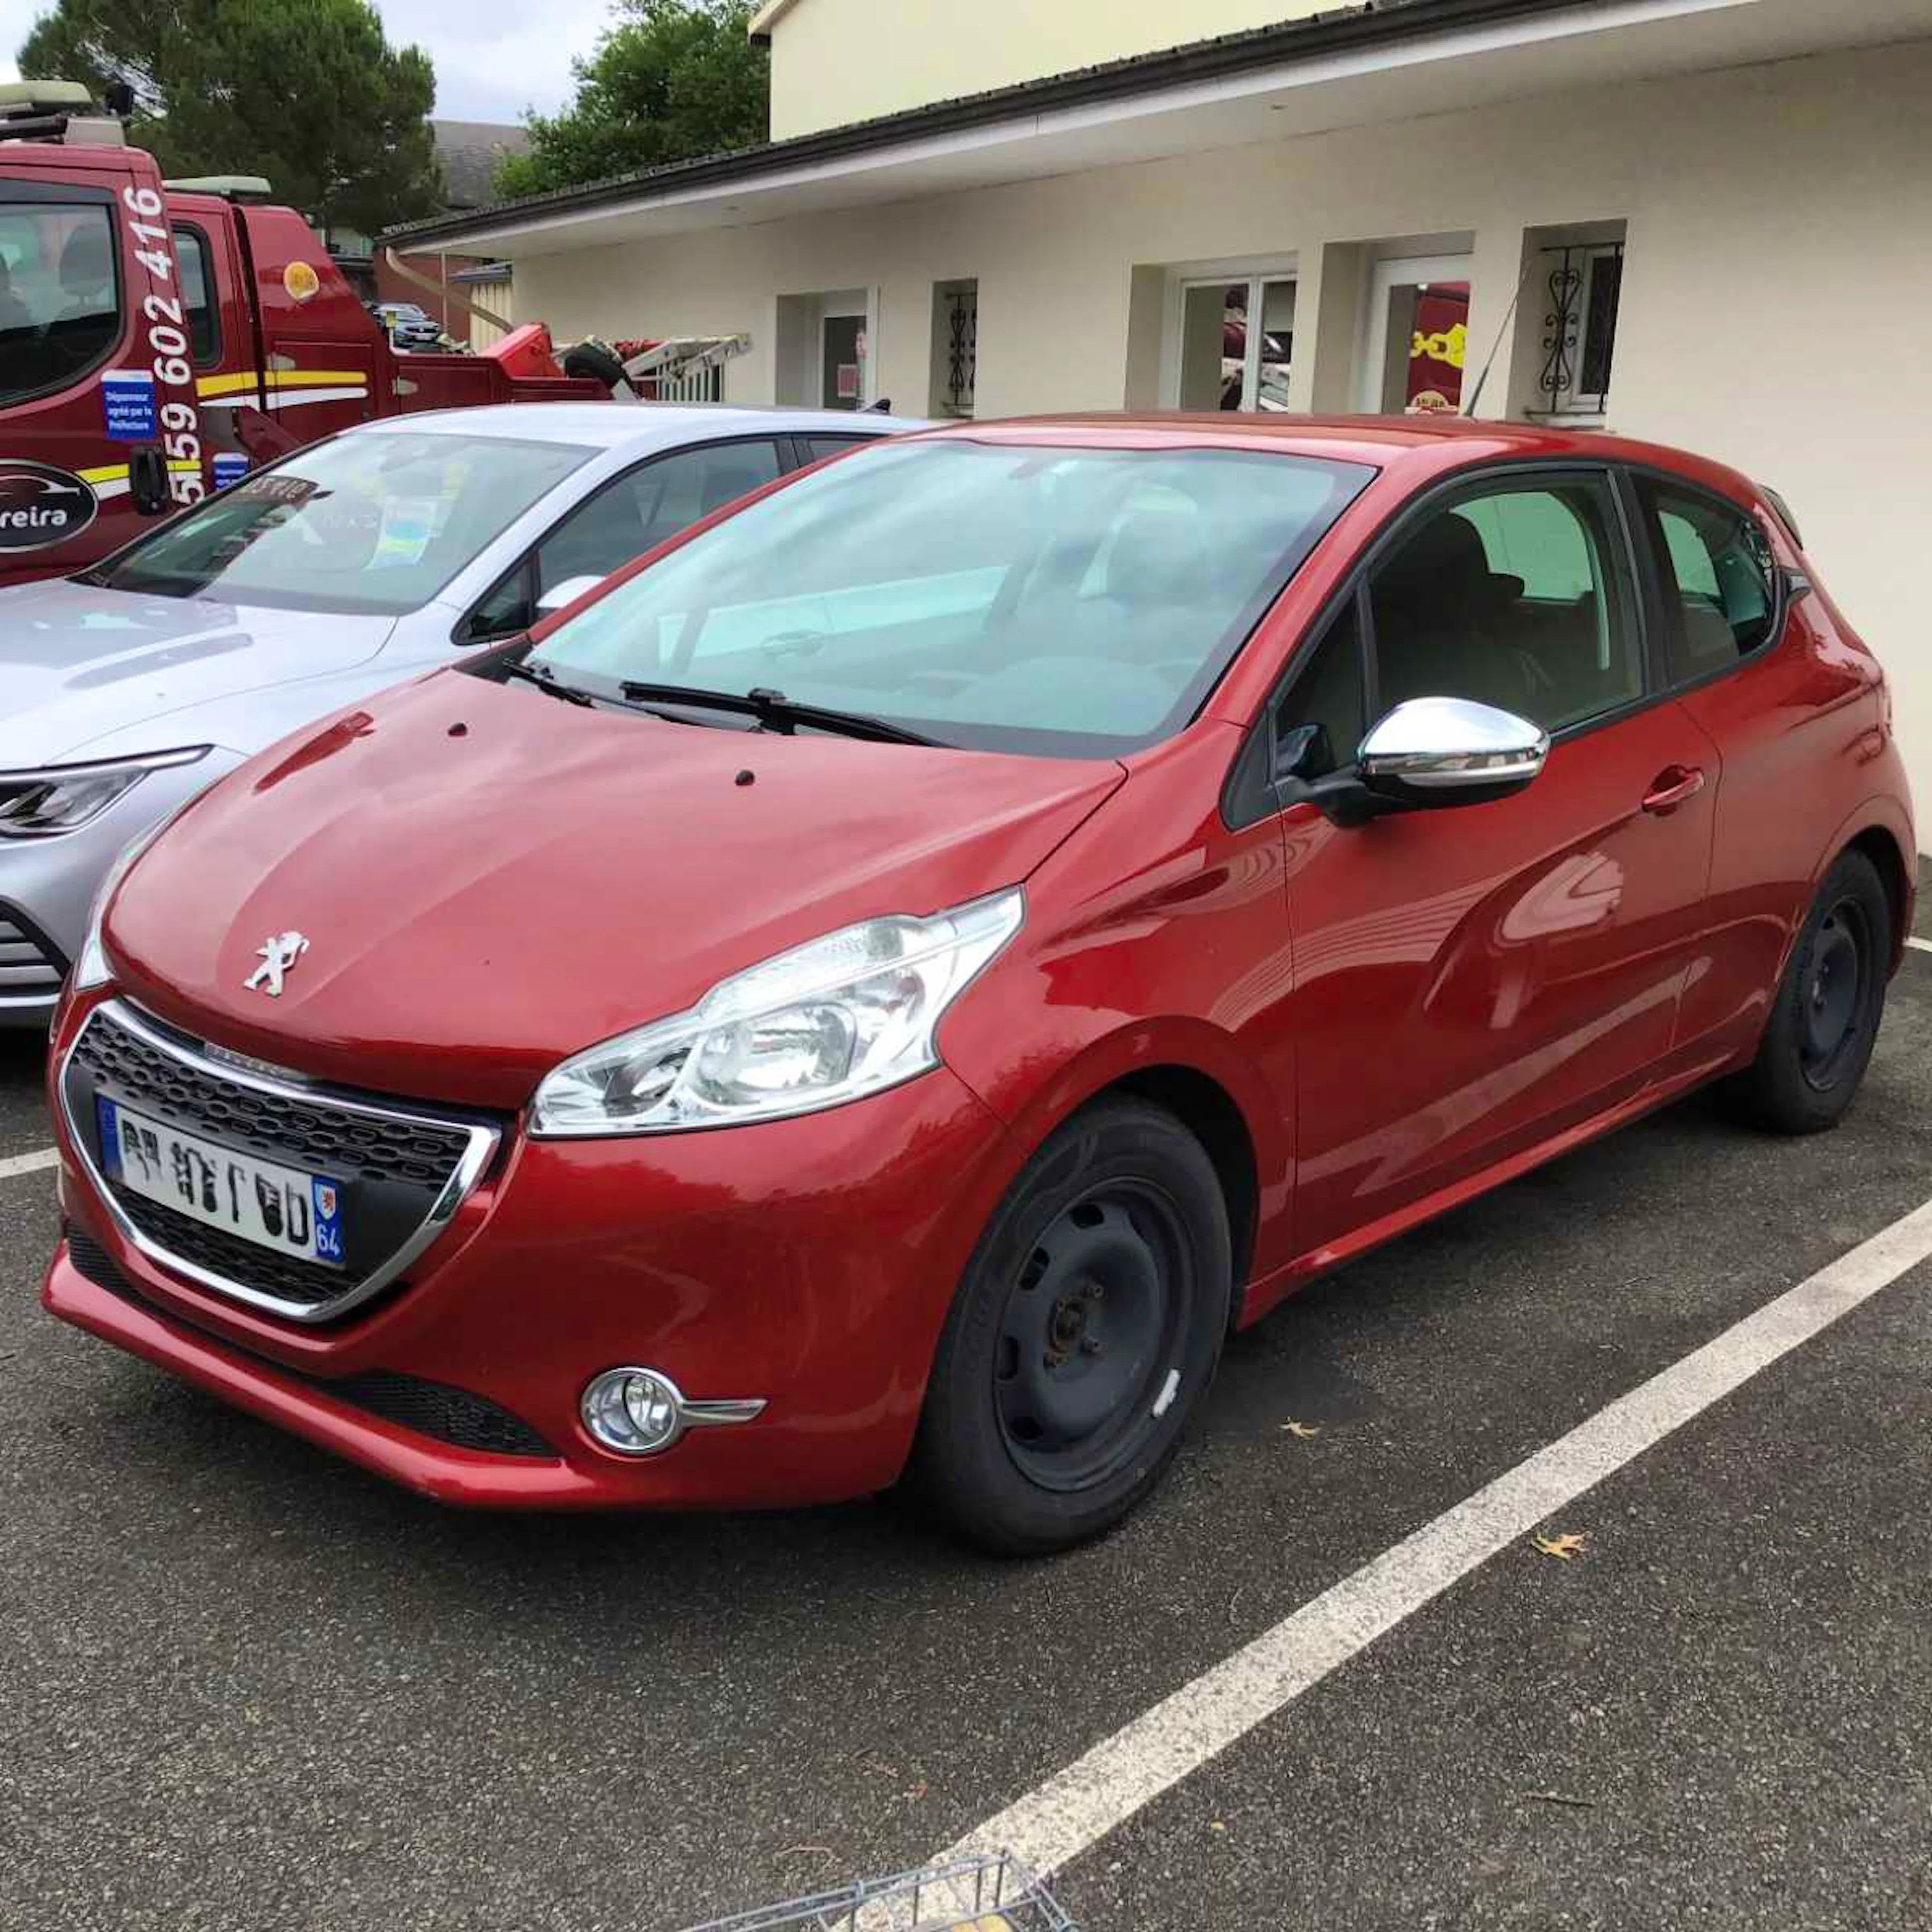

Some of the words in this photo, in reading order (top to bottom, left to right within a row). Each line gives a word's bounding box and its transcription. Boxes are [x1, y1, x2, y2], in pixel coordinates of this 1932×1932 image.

[123, 186, 173, 281] 416
[144, 295, 192, 384] 602
[317, 1223, 340, 1255] 64
